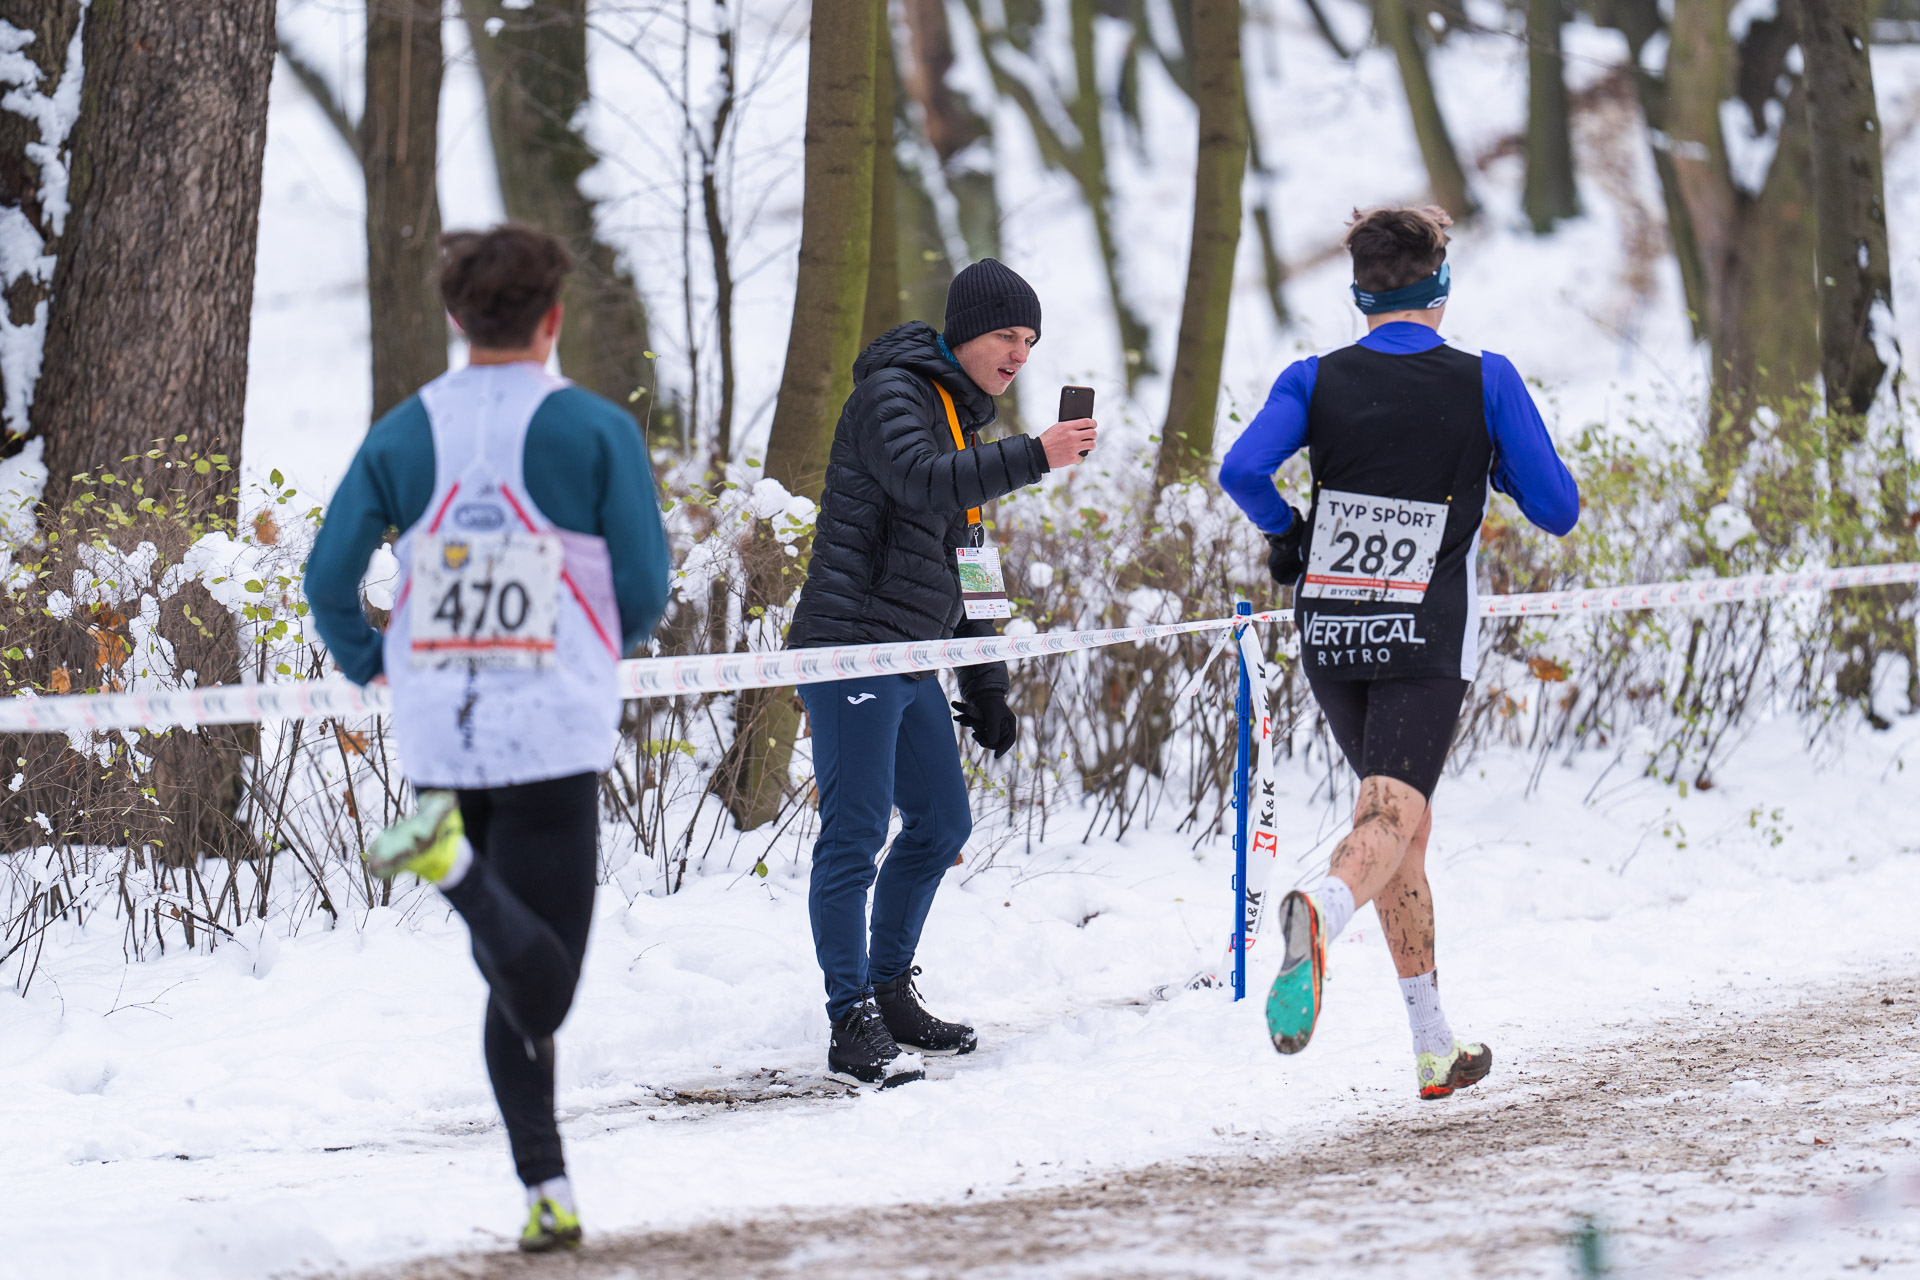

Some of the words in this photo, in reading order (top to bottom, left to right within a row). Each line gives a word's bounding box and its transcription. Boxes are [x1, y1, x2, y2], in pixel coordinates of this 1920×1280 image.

[1328, 501, 1367, 519] TVP
[1372, 507, 1436, 528] SPORT
[1329, 531, 1417, 576] 289
[432, 578, 531, 633] 470
[1303, 611, 1426, 646] VERTICAL
[1317, 648, 1391, 666] RYTRO
